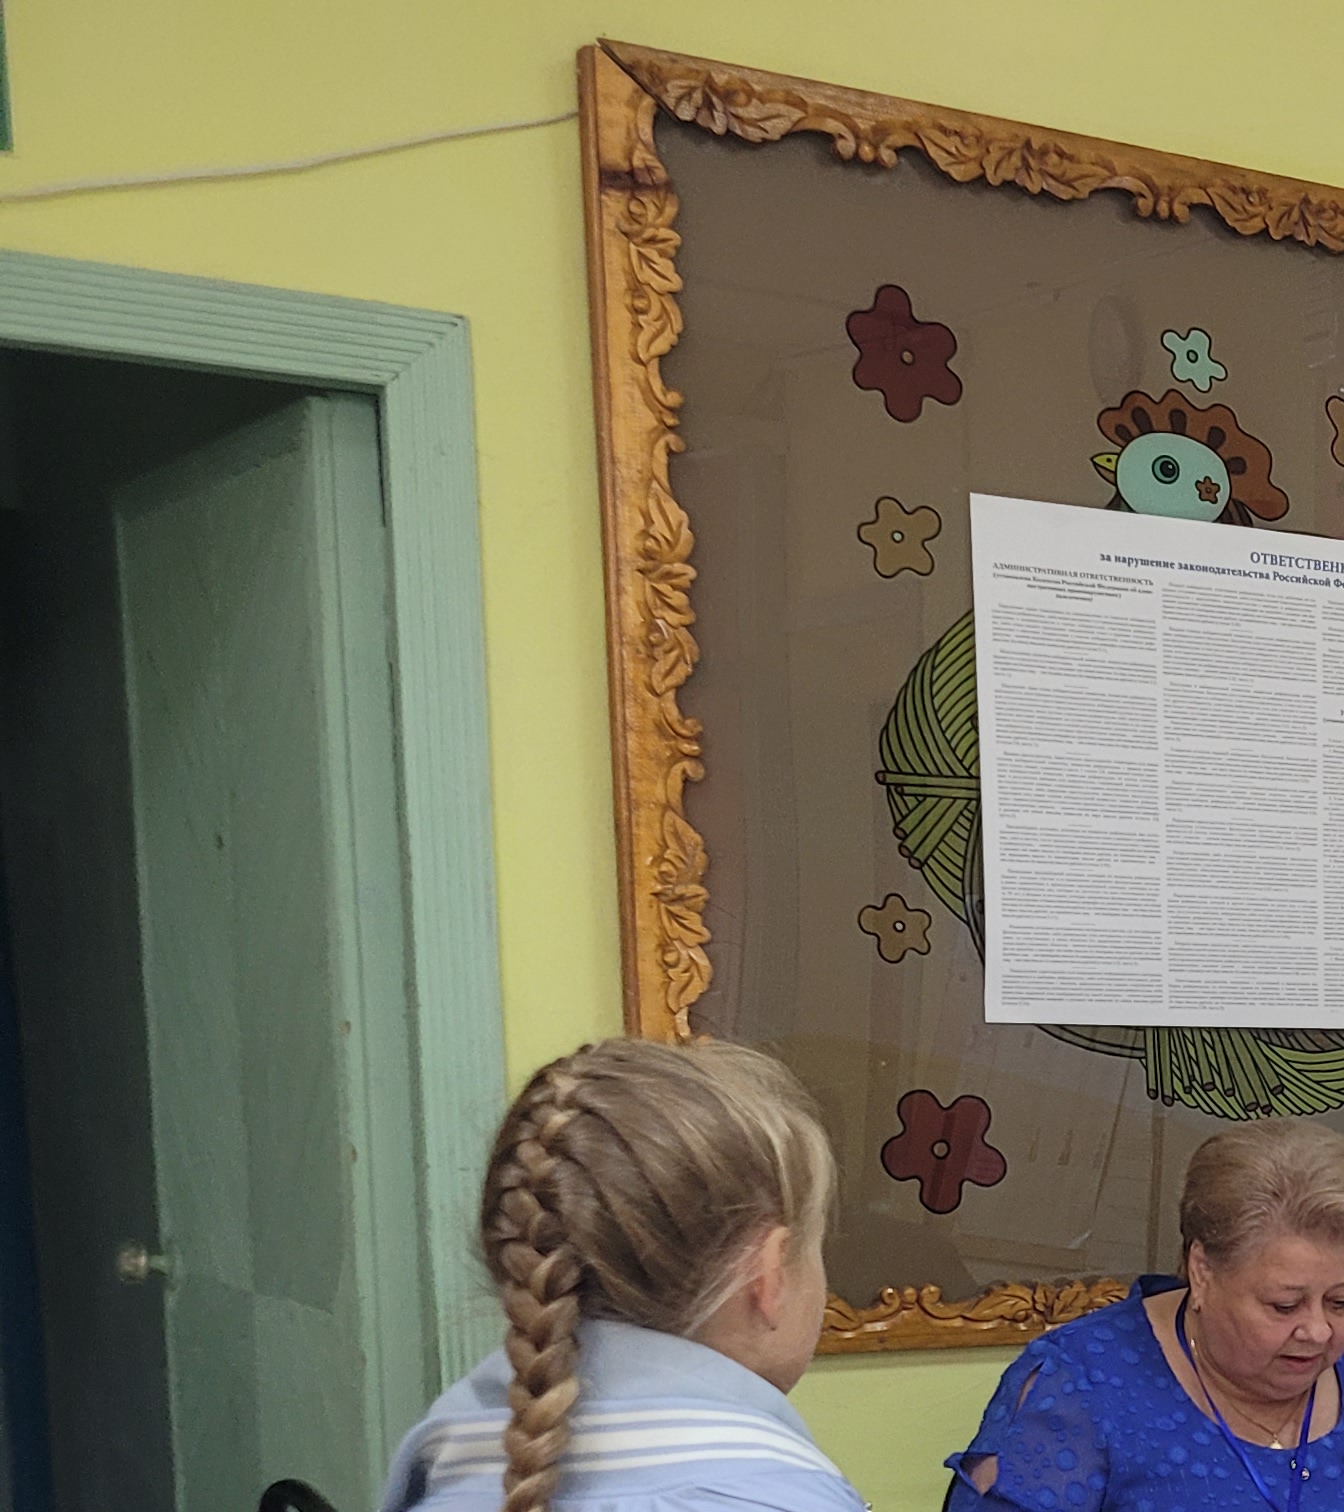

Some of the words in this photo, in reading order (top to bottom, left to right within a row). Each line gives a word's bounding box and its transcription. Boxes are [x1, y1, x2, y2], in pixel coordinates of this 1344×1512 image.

[1100, 553, 1111, 563] за
[1114, 555, 1175, 570] нарушение
[1178, 561, 1271, 580] законодательства
[1272, 571, 1331, 587] Российской
